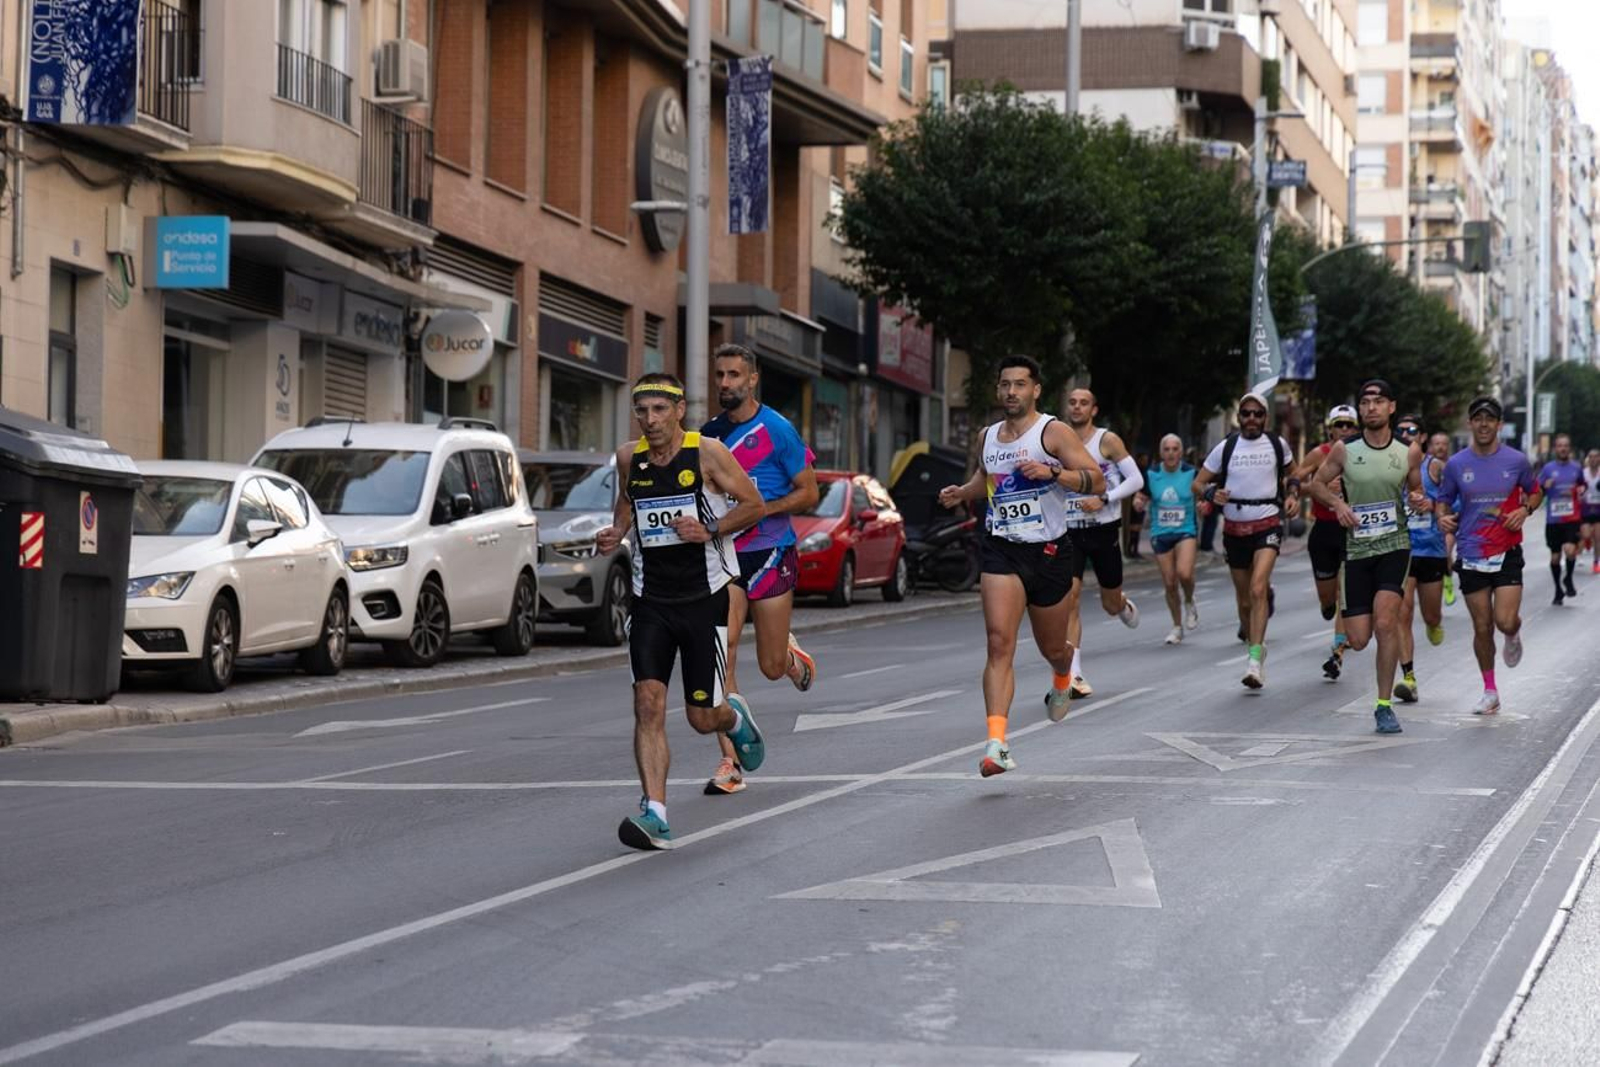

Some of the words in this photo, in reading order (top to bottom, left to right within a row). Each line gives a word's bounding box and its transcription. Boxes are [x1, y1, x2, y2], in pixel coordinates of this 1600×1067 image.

[51, 22, 65, 64] JUAN
[163, 231, 217, 245] endesa
[171, 262, 217, 274] Servicio
[445, 334, 486, 354] Jucar
[1000, 503, 1031, 520] 930
[1361, 507, 1389, 525] 253
